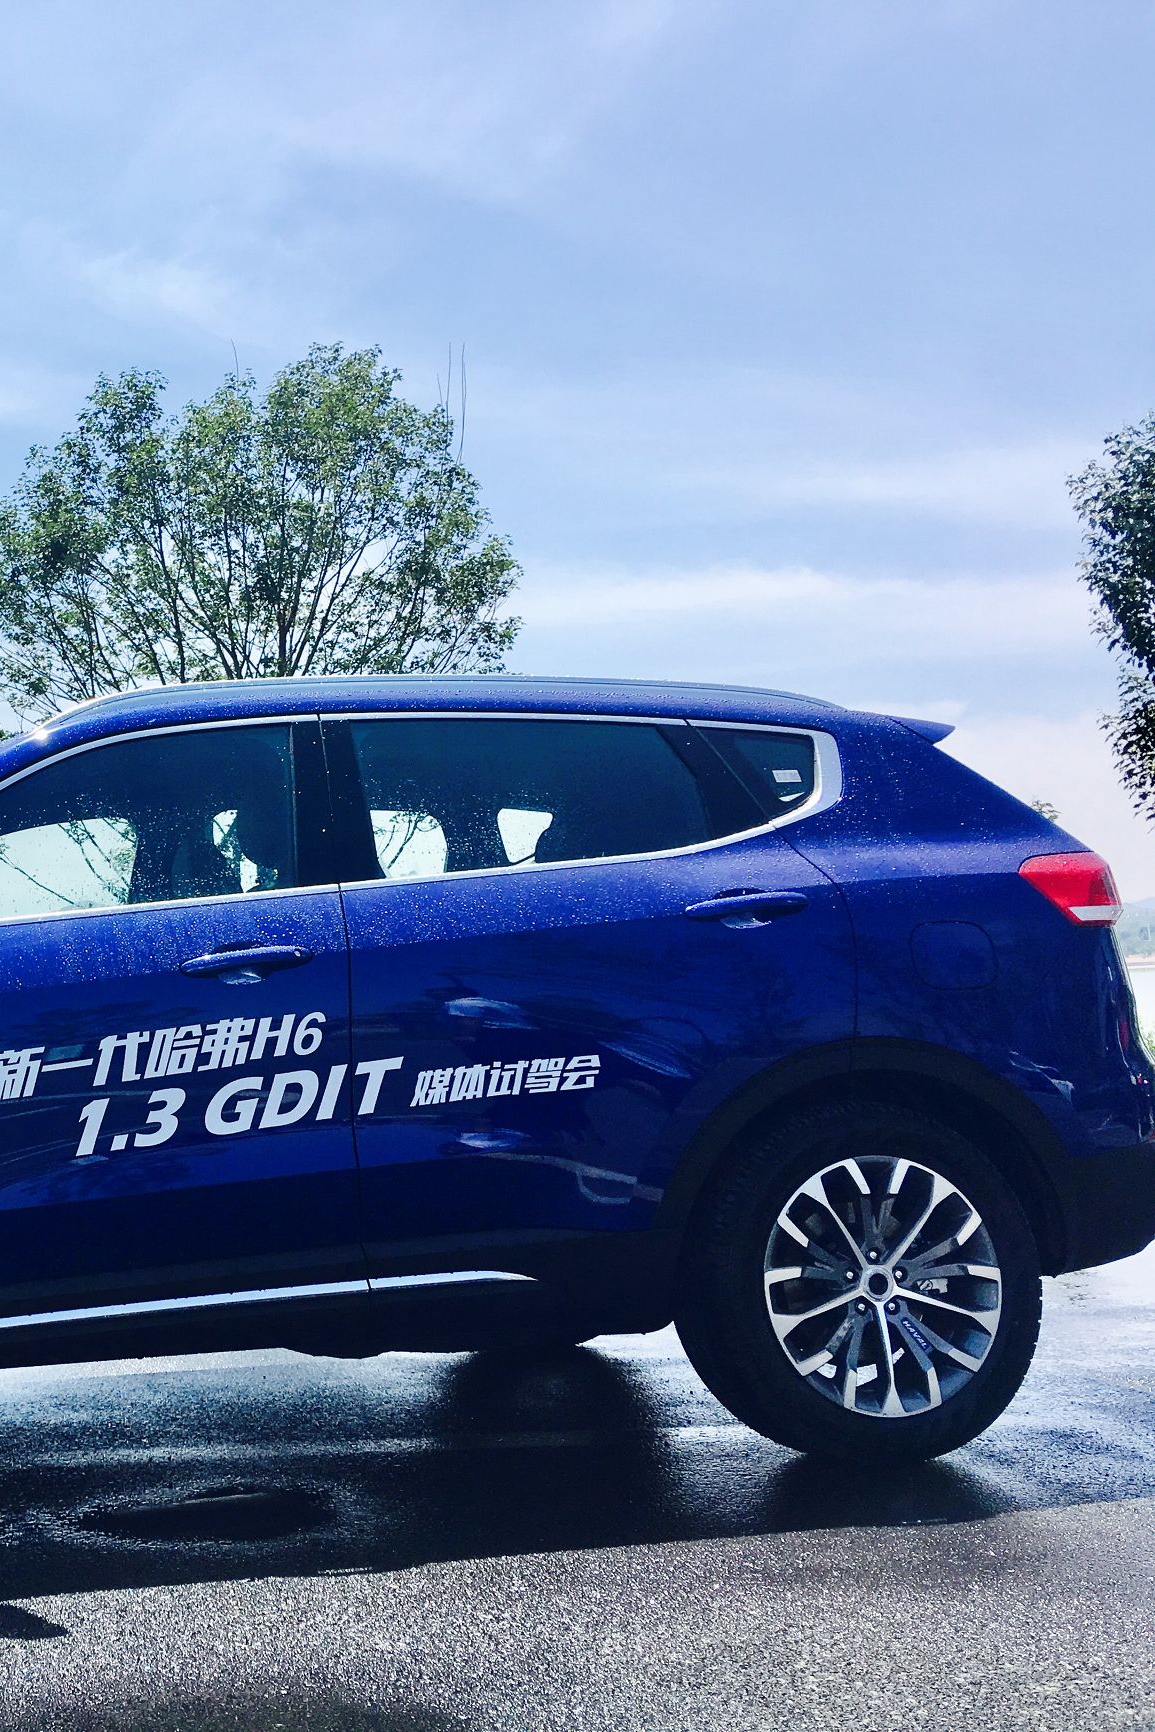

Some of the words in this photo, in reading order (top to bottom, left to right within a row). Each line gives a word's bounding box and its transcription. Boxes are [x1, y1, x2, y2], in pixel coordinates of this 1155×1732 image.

[75, 1087, 186, 1157] 1.3
[204, 1055, 405, 1136] GDIT
[409, 1054, 601, 1107] 媒体试驾会
[902, 1320, 927, 1348] HAVAL
